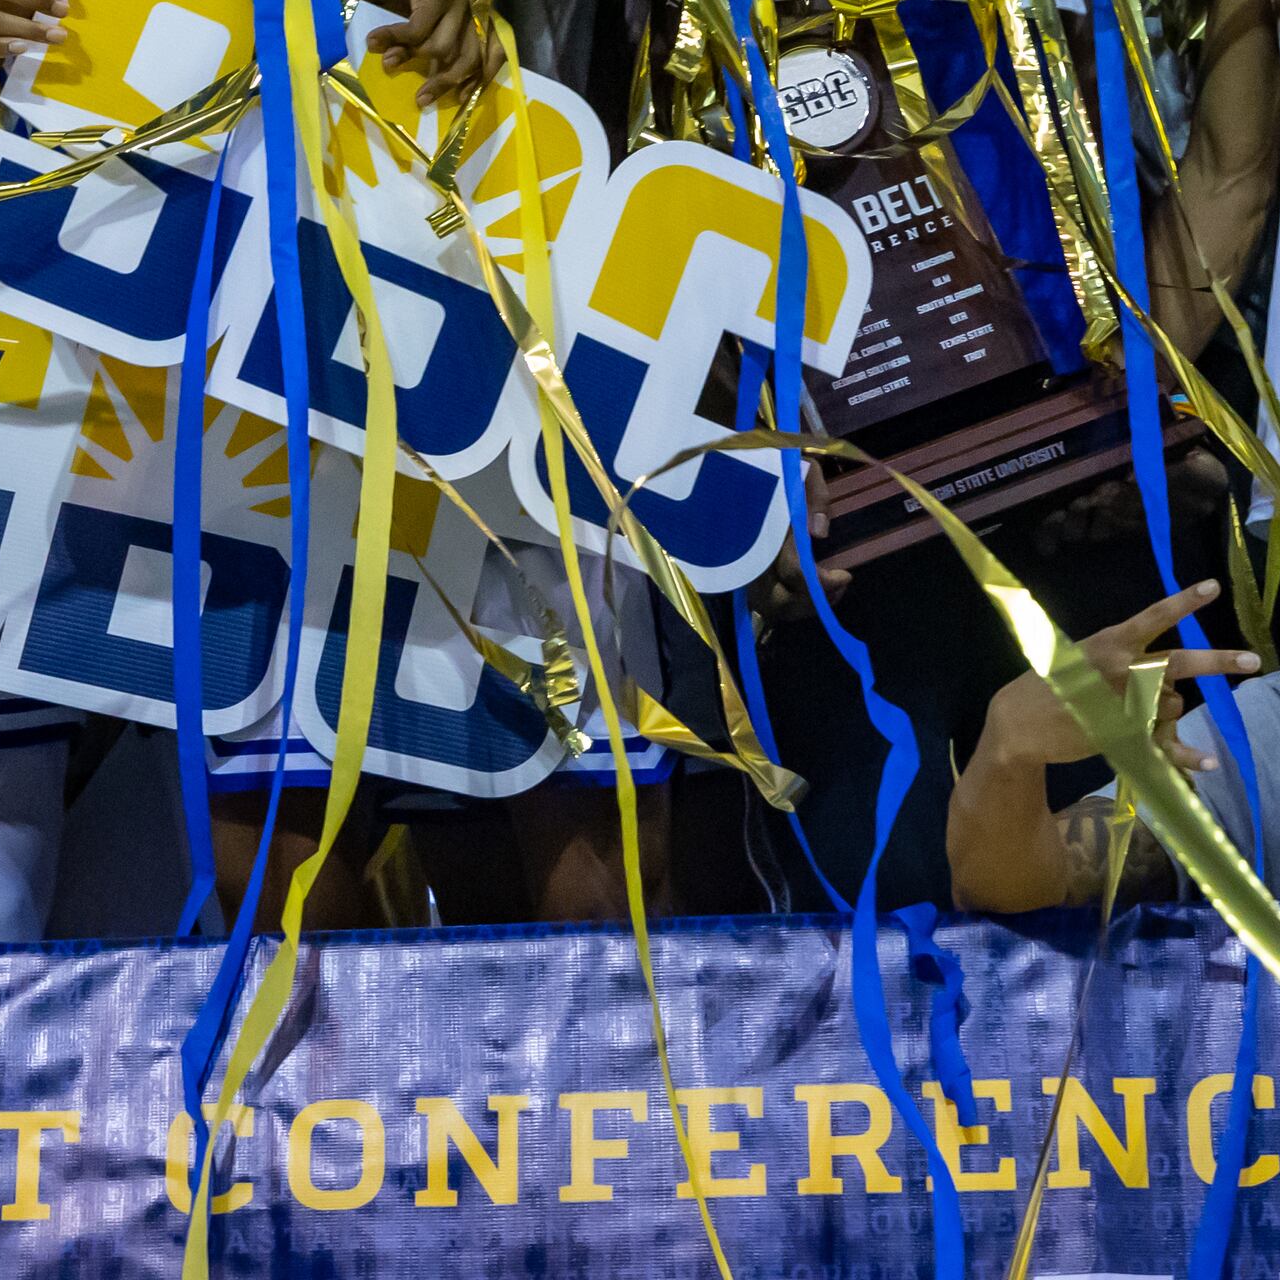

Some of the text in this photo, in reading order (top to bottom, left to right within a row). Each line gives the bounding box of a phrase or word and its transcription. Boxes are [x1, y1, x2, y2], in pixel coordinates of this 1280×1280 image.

[780, 69, 859, 125] SBC
[852, 174, 945, 235] BELT
[871, 215, 954, 254] RENCE
[954, 468, 997, 494] STATE
[994, 440, 1067, 480] UNIVERSITY
